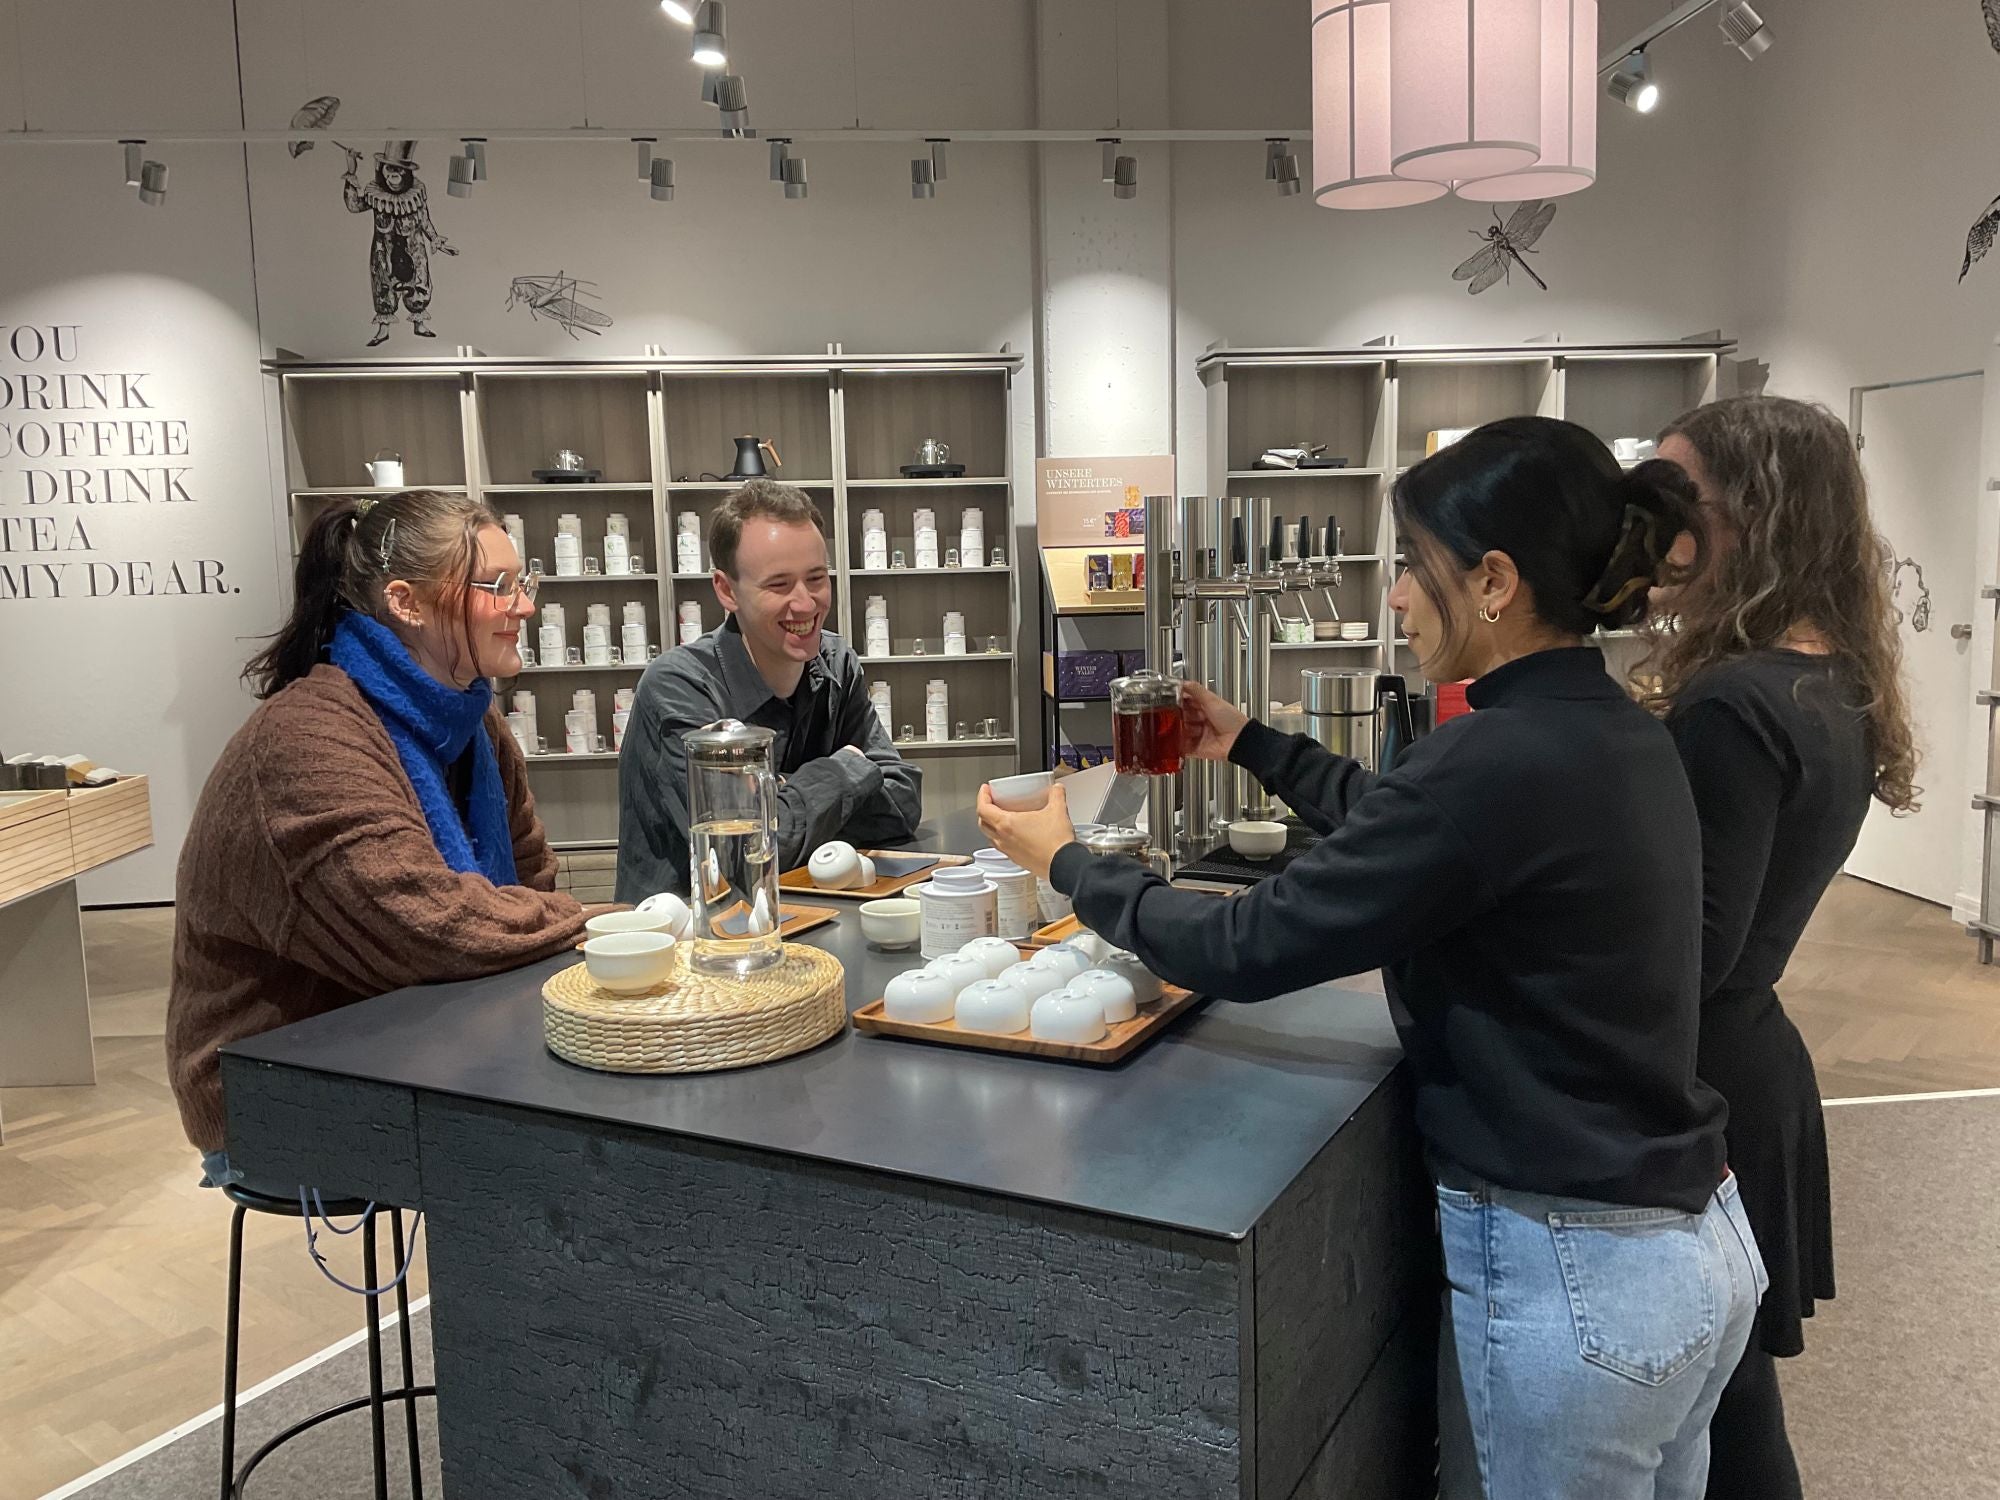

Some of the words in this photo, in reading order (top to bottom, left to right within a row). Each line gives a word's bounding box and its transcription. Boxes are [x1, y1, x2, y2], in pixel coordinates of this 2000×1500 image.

[0, 325, 83, 363] OU
[20, 467, 198, 506] DRINK
[1045, 468, 1092, 479] UNSERE
[1046, 477, 1123, 489] WINTERTEES
[0, 515, 96, 552] TEA
[0, 562, 72, 600] MY
[81, 559, 241, 598] DEAR.
